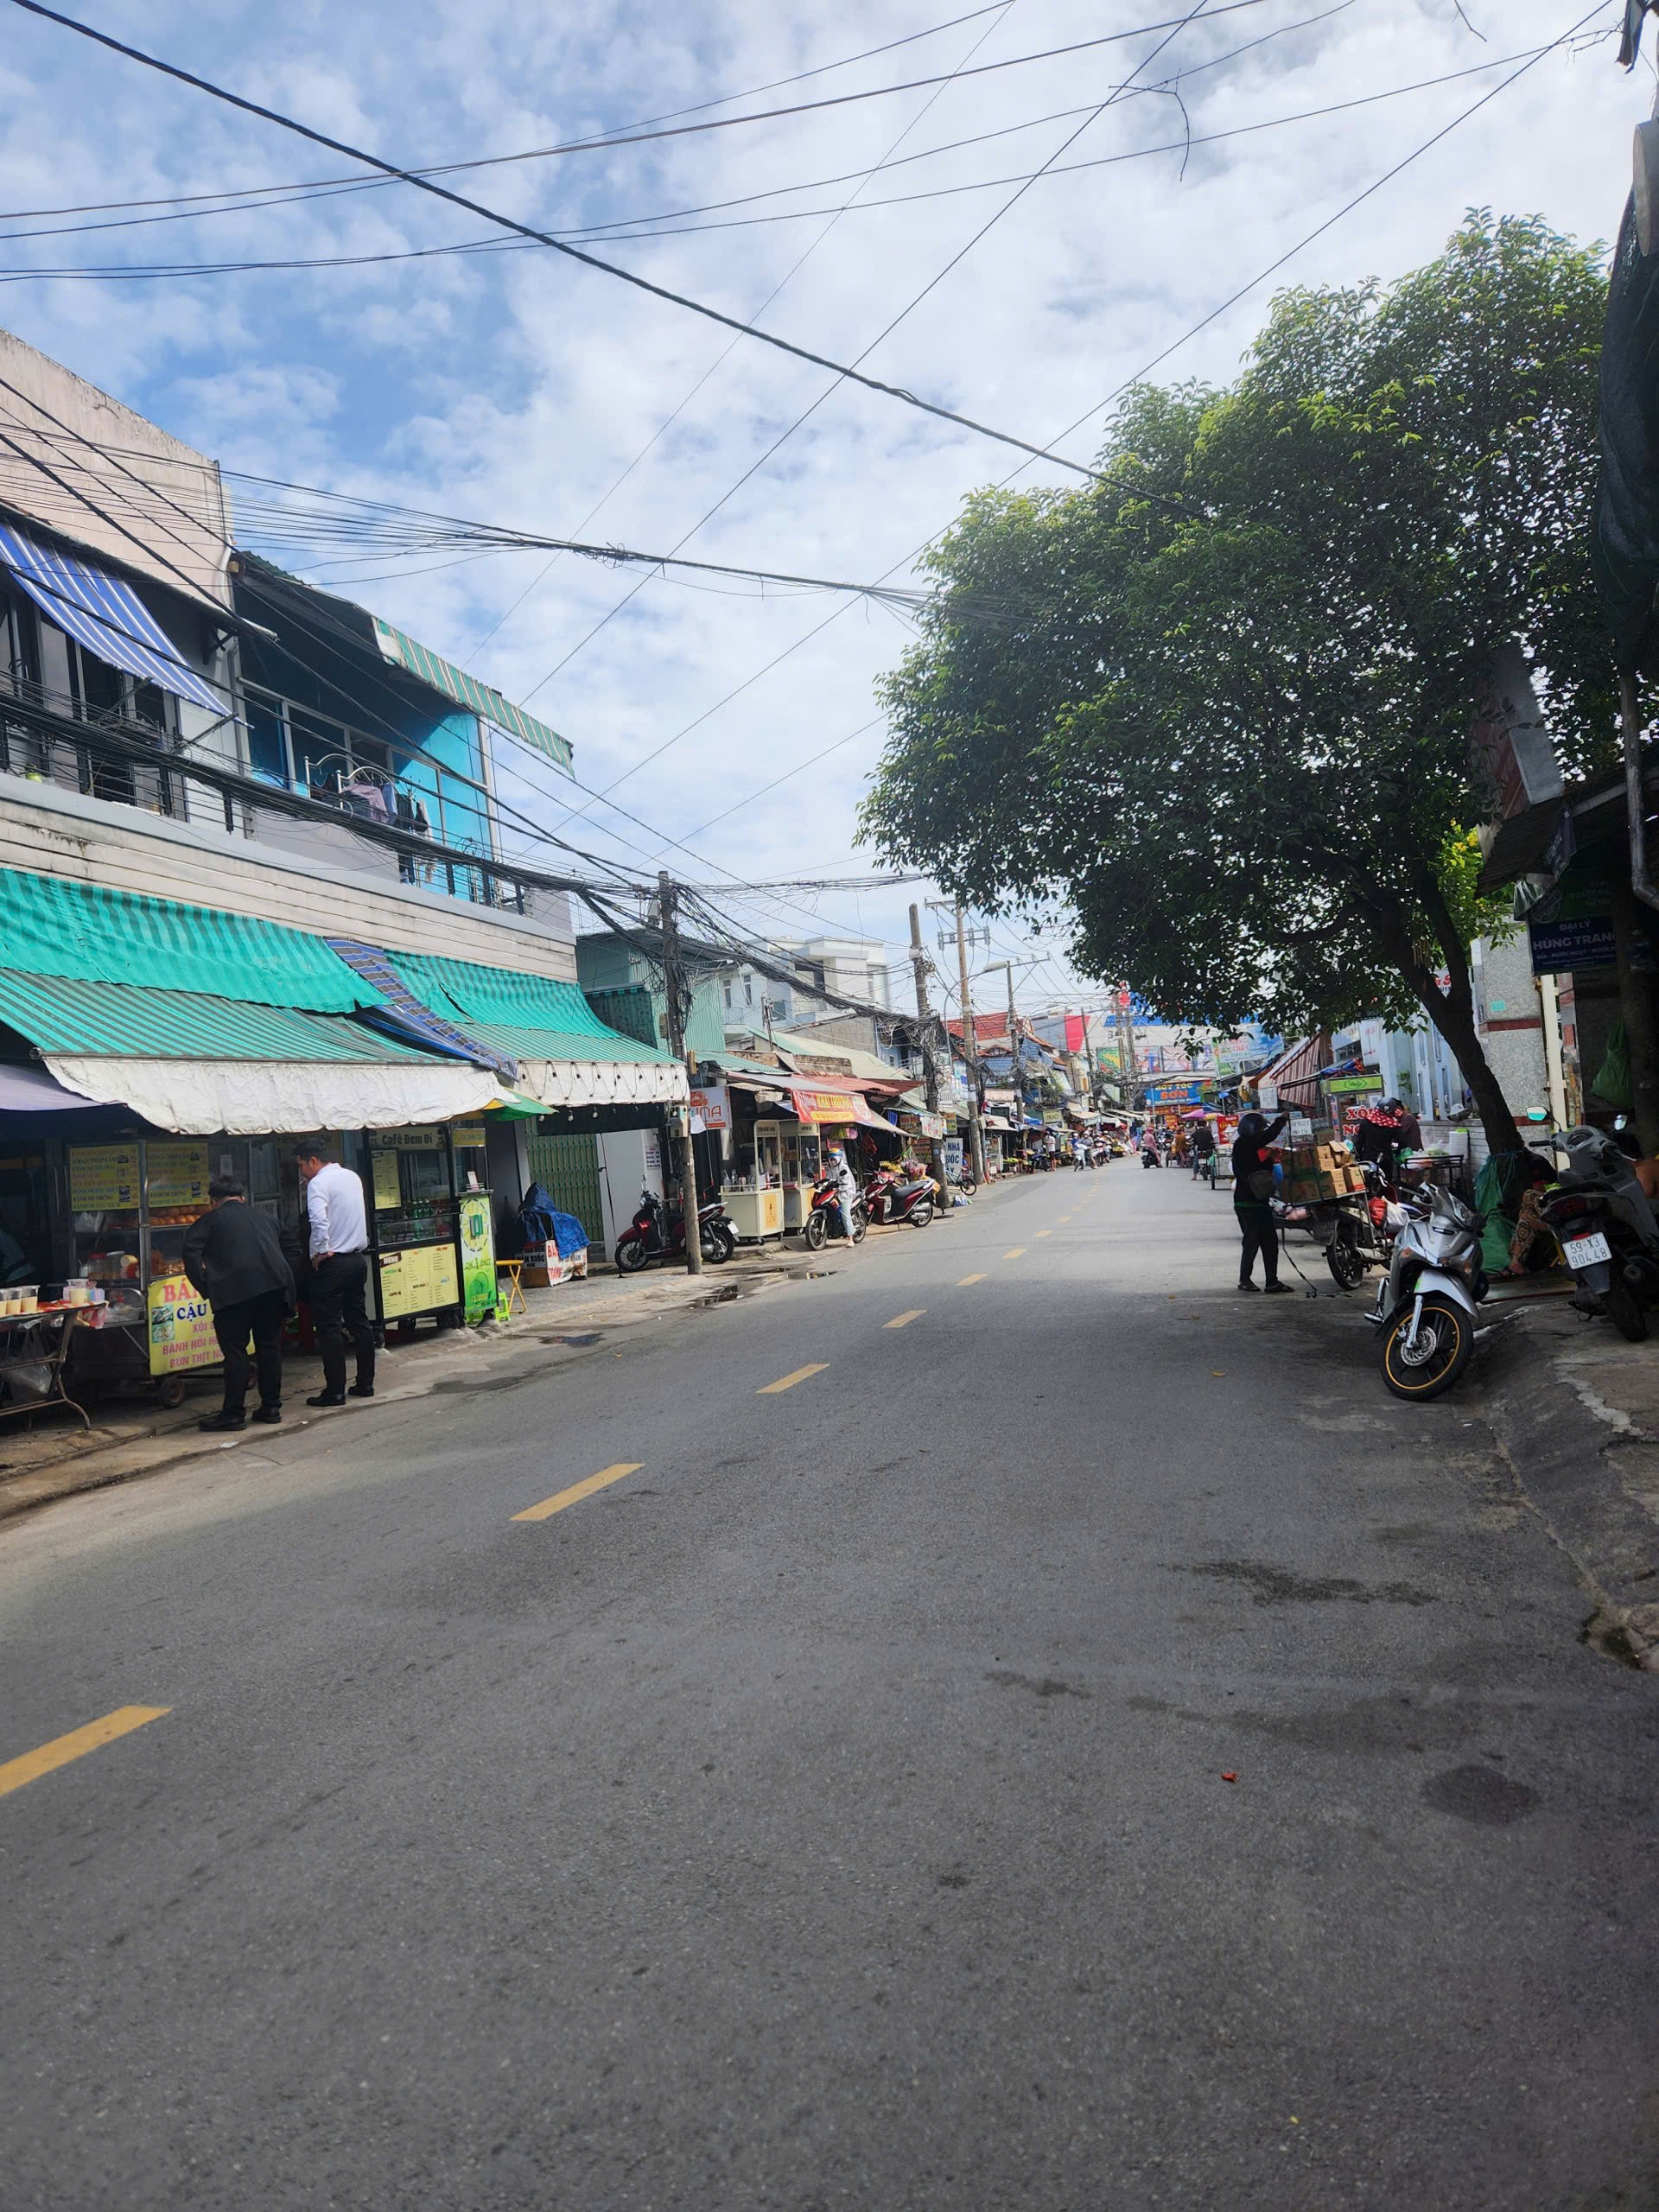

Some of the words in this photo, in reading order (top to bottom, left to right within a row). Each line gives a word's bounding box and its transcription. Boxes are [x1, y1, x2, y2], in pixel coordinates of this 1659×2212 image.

[948, 1141, 960, 1151] NHÀ
[1570, 1236, 1600, 1254] 59-X3
[1571, 1247, 1608, 1266] 904.48
[176, 1302, 207, 1321] CẬU
